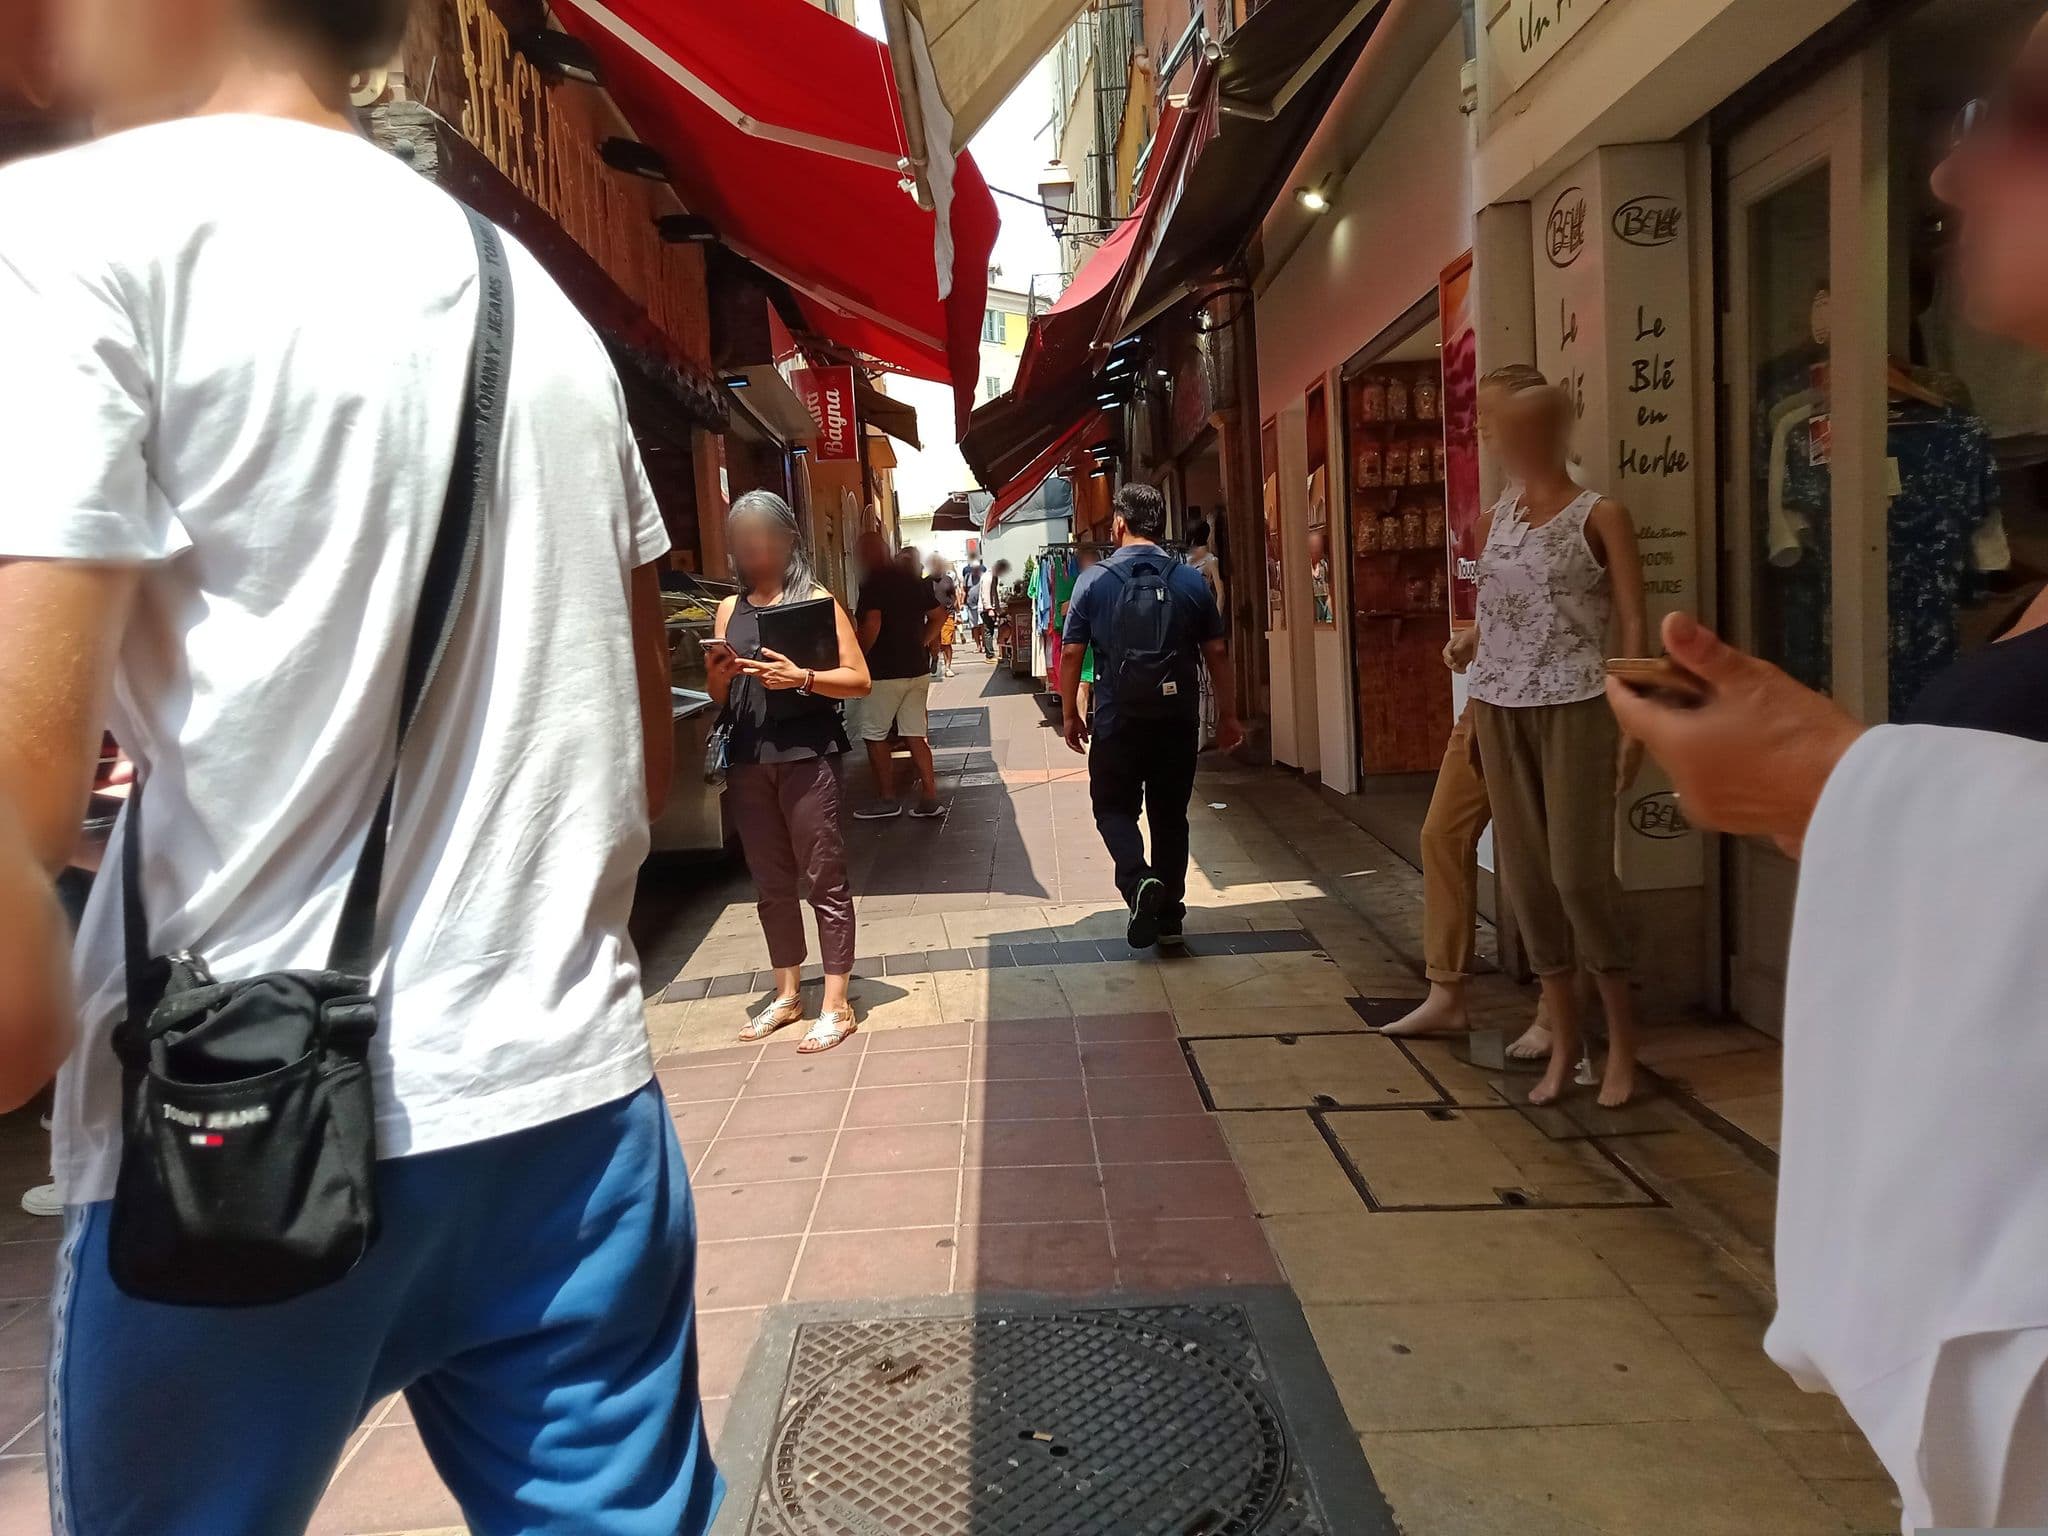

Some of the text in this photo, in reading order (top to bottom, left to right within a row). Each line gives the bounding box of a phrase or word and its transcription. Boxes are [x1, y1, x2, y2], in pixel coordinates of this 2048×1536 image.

[486, 275, 504, 338] JEANS
[1560, 297, 1578, 352] Le
[1634, 305, 1667, 342] Le
[1628, 353, 1676, 394] Blé
[824, 387, 848, 456] Bagna
[1637, 405, 1668, 427] en
[1617, 434, 1690, 480] Herbe
